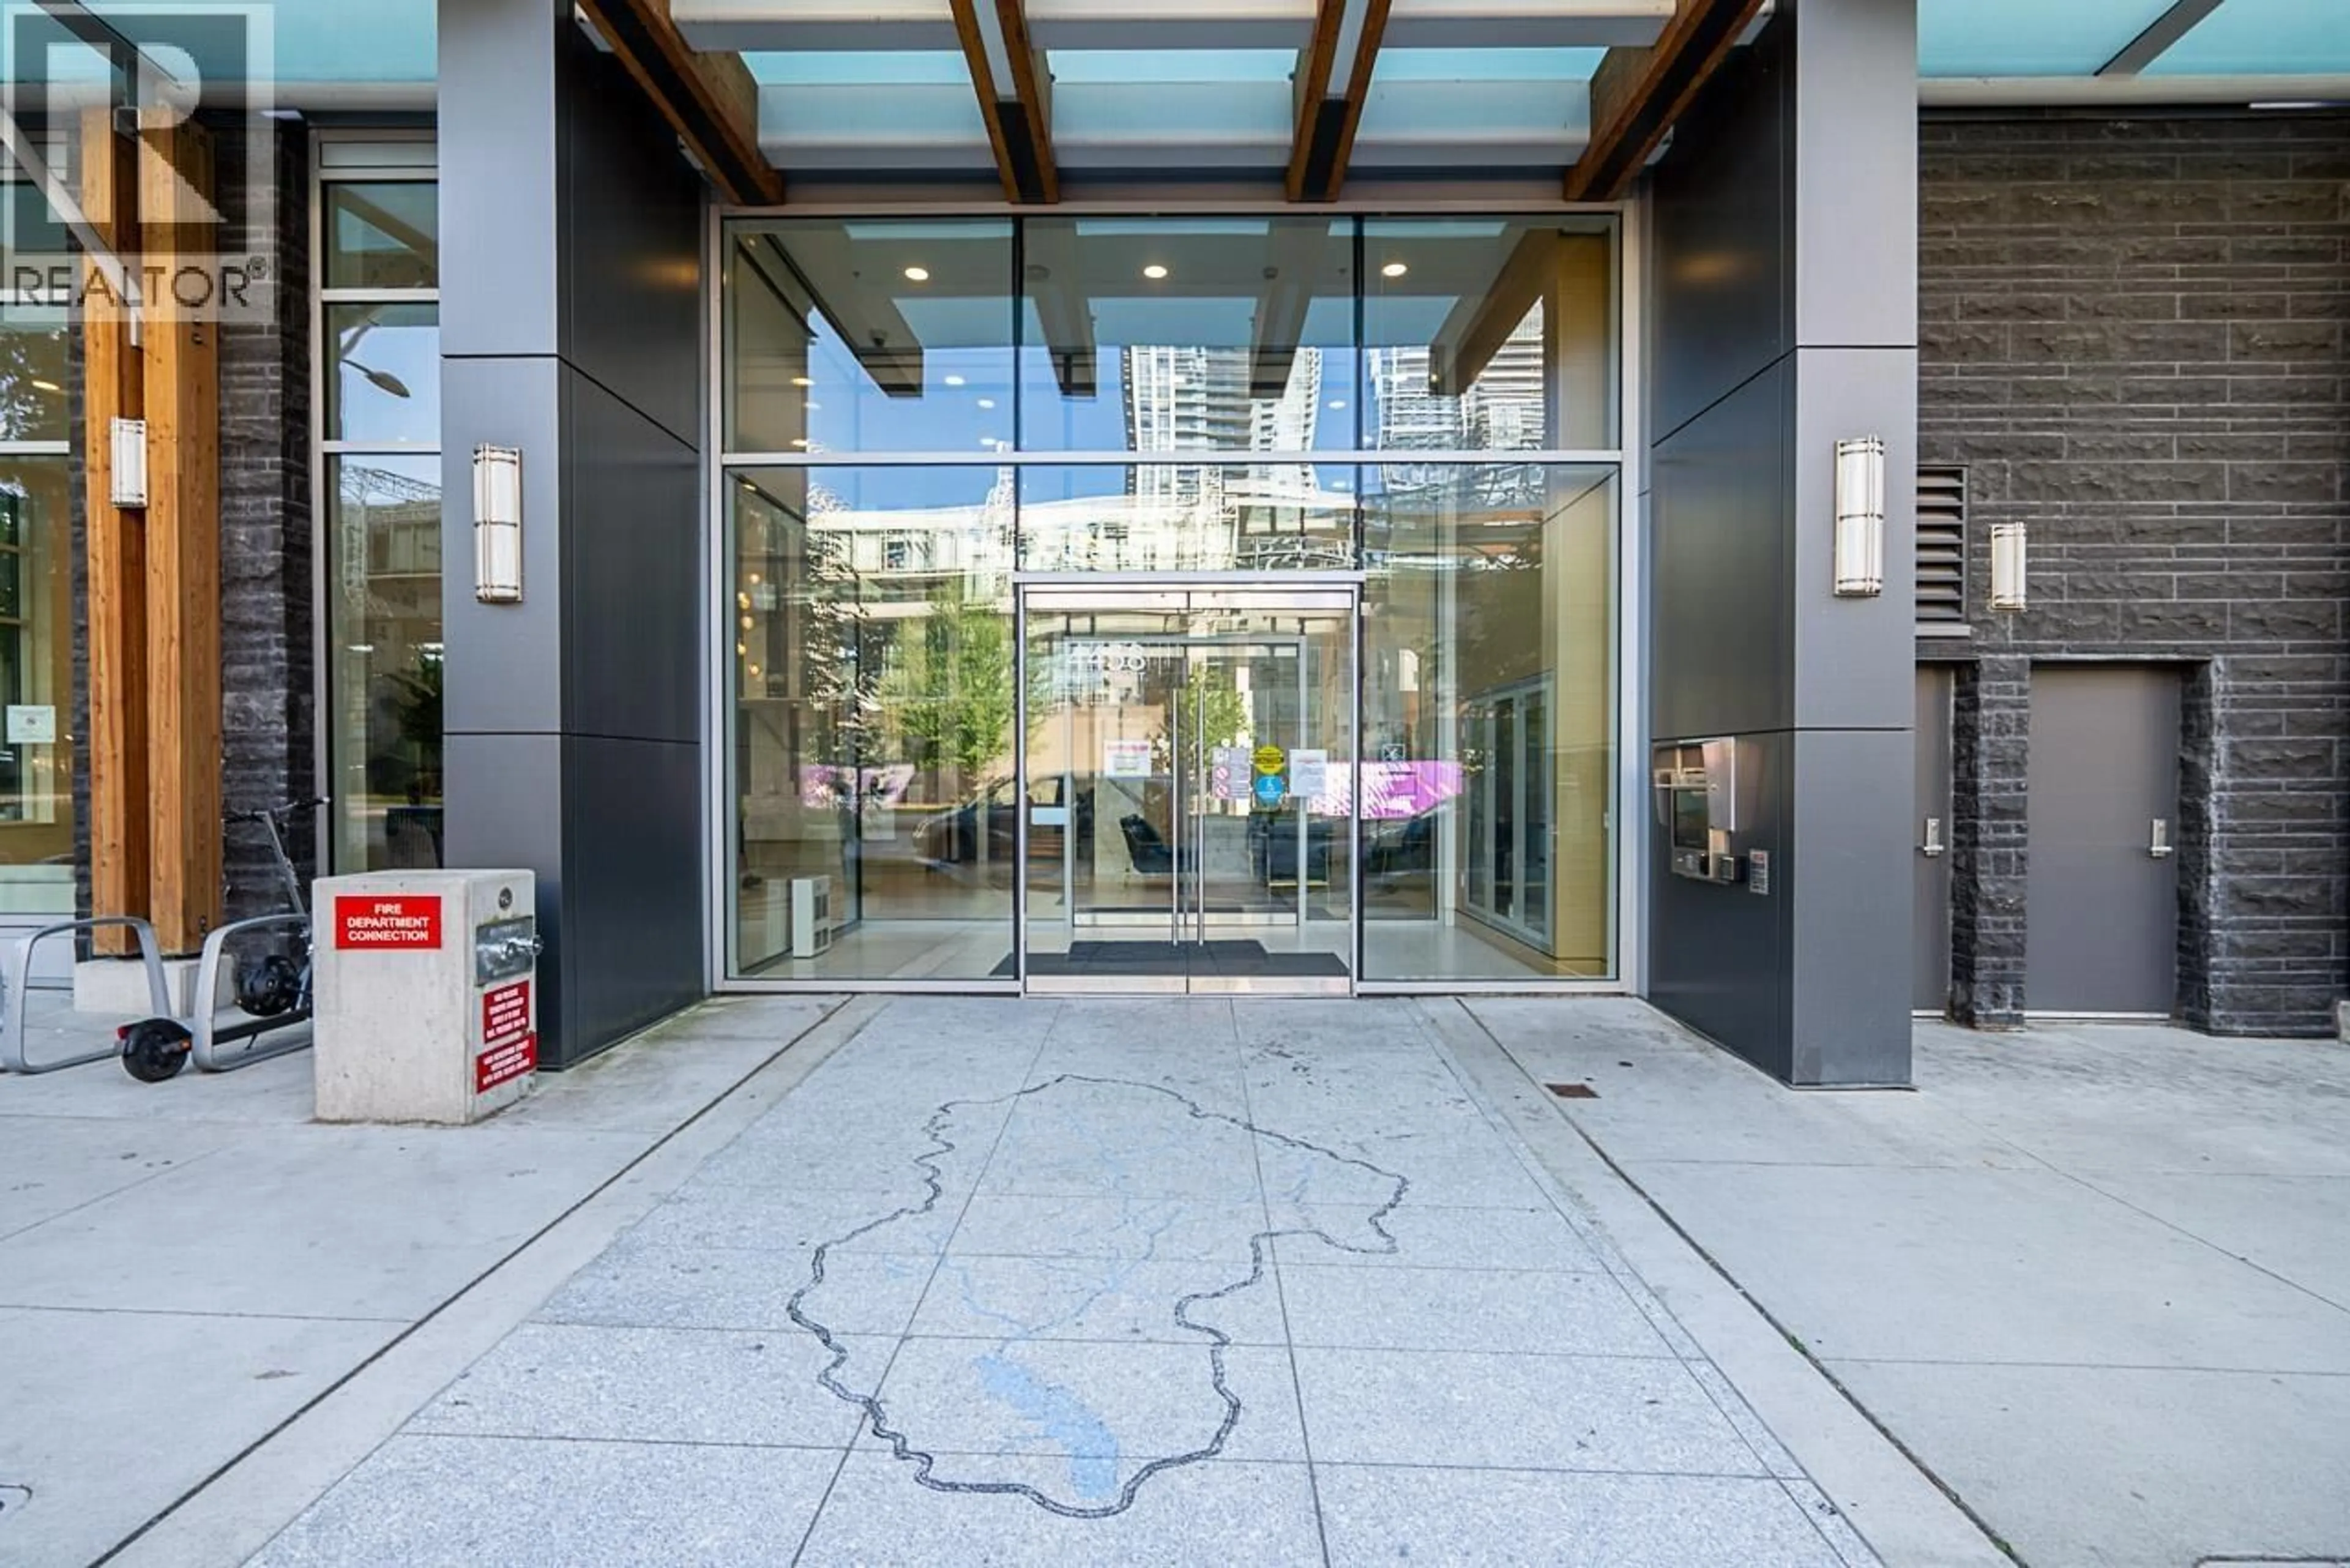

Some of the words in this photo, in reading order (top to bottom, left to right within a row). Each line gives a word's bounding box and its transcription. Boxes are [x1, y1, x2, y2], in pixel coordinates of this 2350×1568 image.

[374, 903, 402, 915] FIRE
[346, 917, 430, 928] DEPARTMENT
[348, 930, 429, 941] CONNECTION
